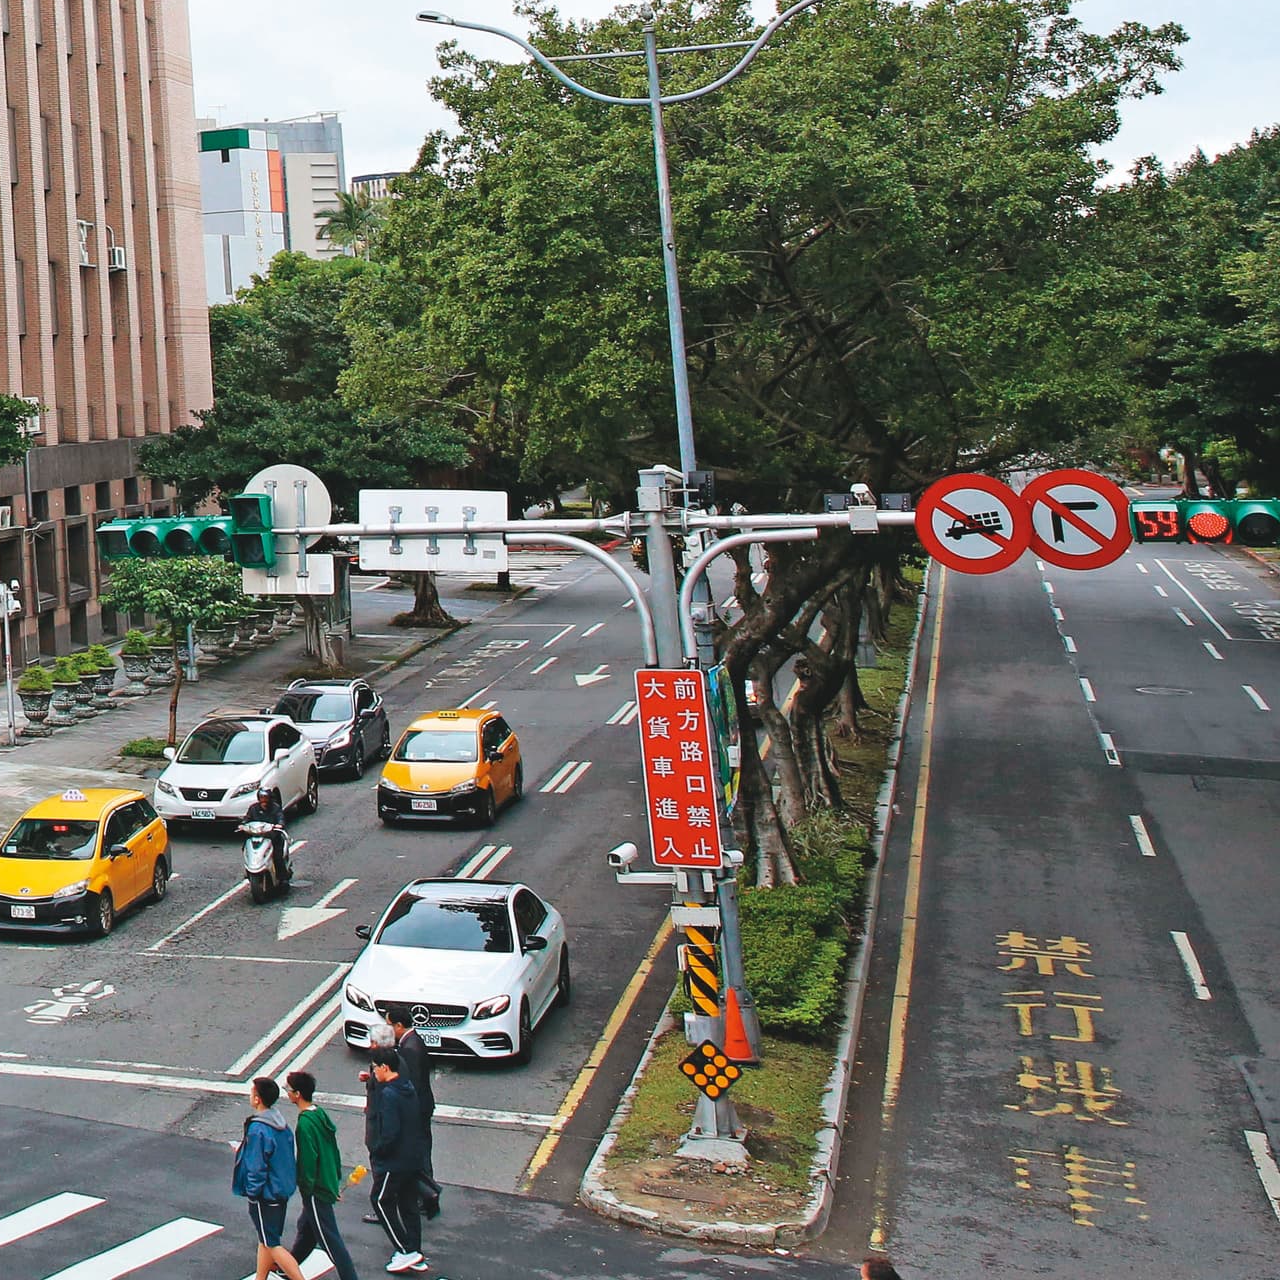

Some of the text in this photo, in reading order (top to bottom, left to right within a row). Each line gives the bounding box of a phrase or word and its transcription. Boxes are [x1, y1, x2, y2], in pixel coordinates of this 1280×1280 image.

[674, 678, 716, 861] 前方路口禁止
